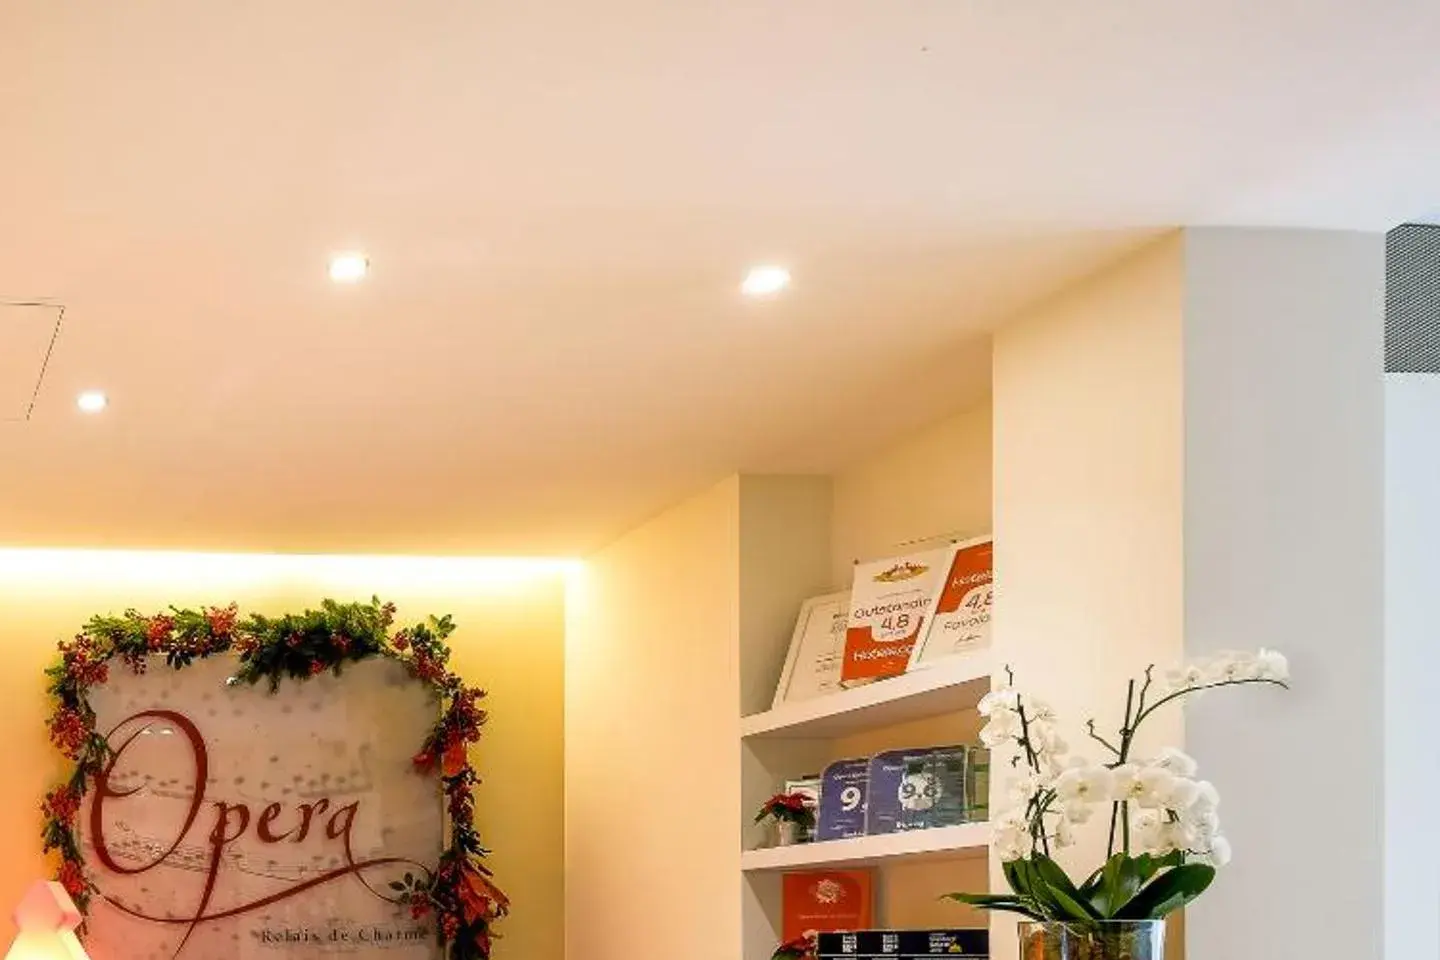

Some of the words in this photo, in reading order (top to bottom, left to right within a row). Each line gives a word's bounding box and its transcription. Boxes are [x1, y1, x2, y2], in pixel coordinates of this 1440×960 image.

[261, 928, 321, 944] Relais
[328, 928, 349, 943] de
[358, 927, 428, 943] Charme
